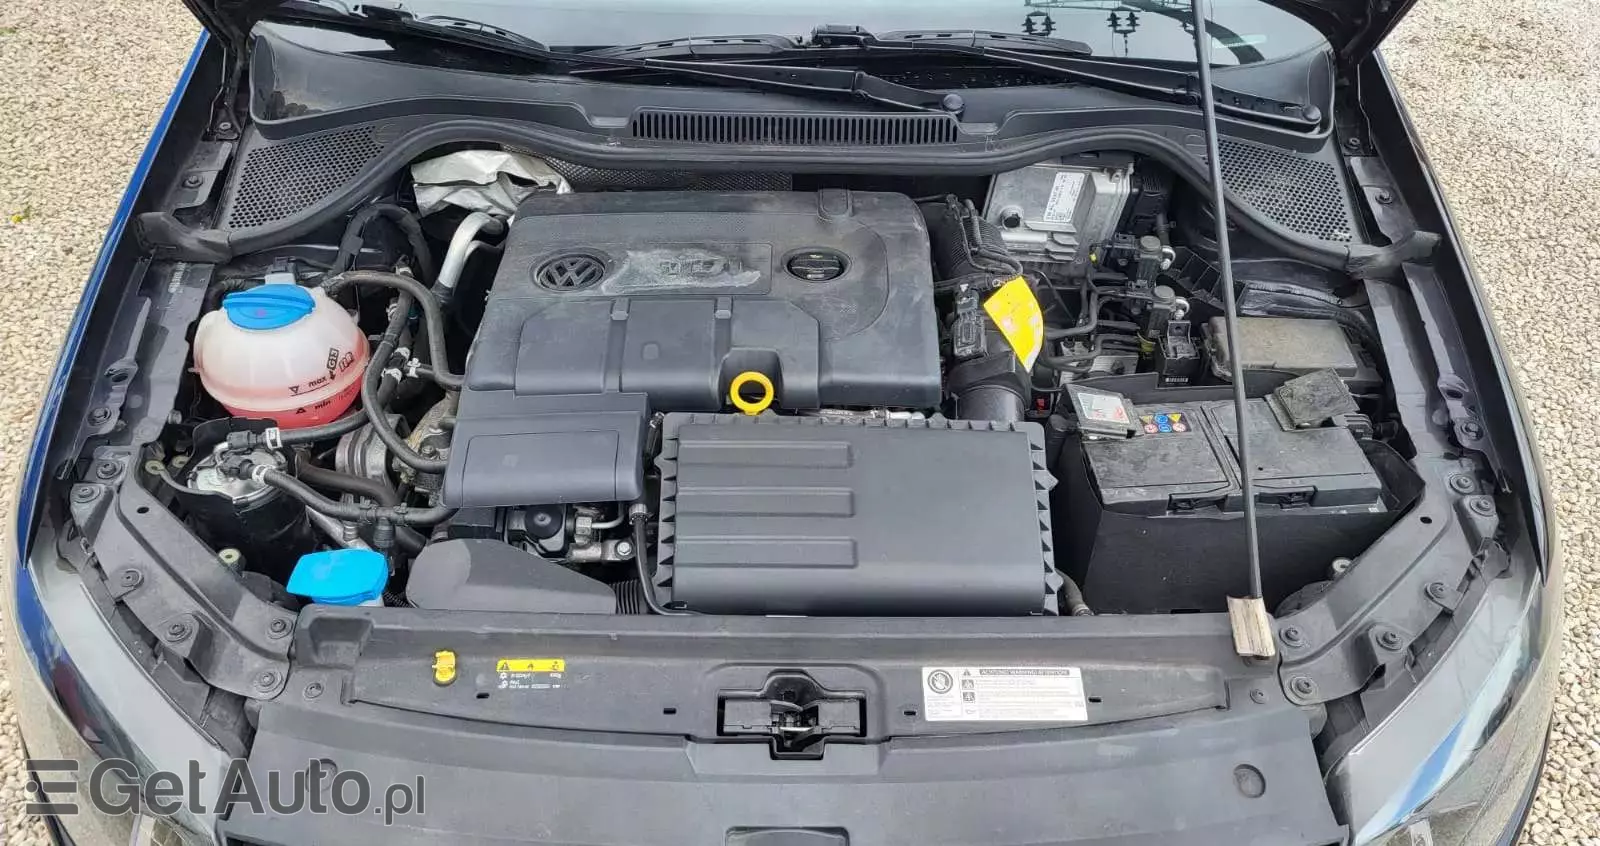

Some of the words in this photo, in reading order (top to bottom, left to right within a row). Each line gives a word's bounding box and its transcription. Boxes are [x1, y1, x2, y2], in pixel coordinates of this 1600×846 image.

[328, 349, 339, 369] G13
[308, 375, 328, 388] max
[315, 399, 331, 410] min
